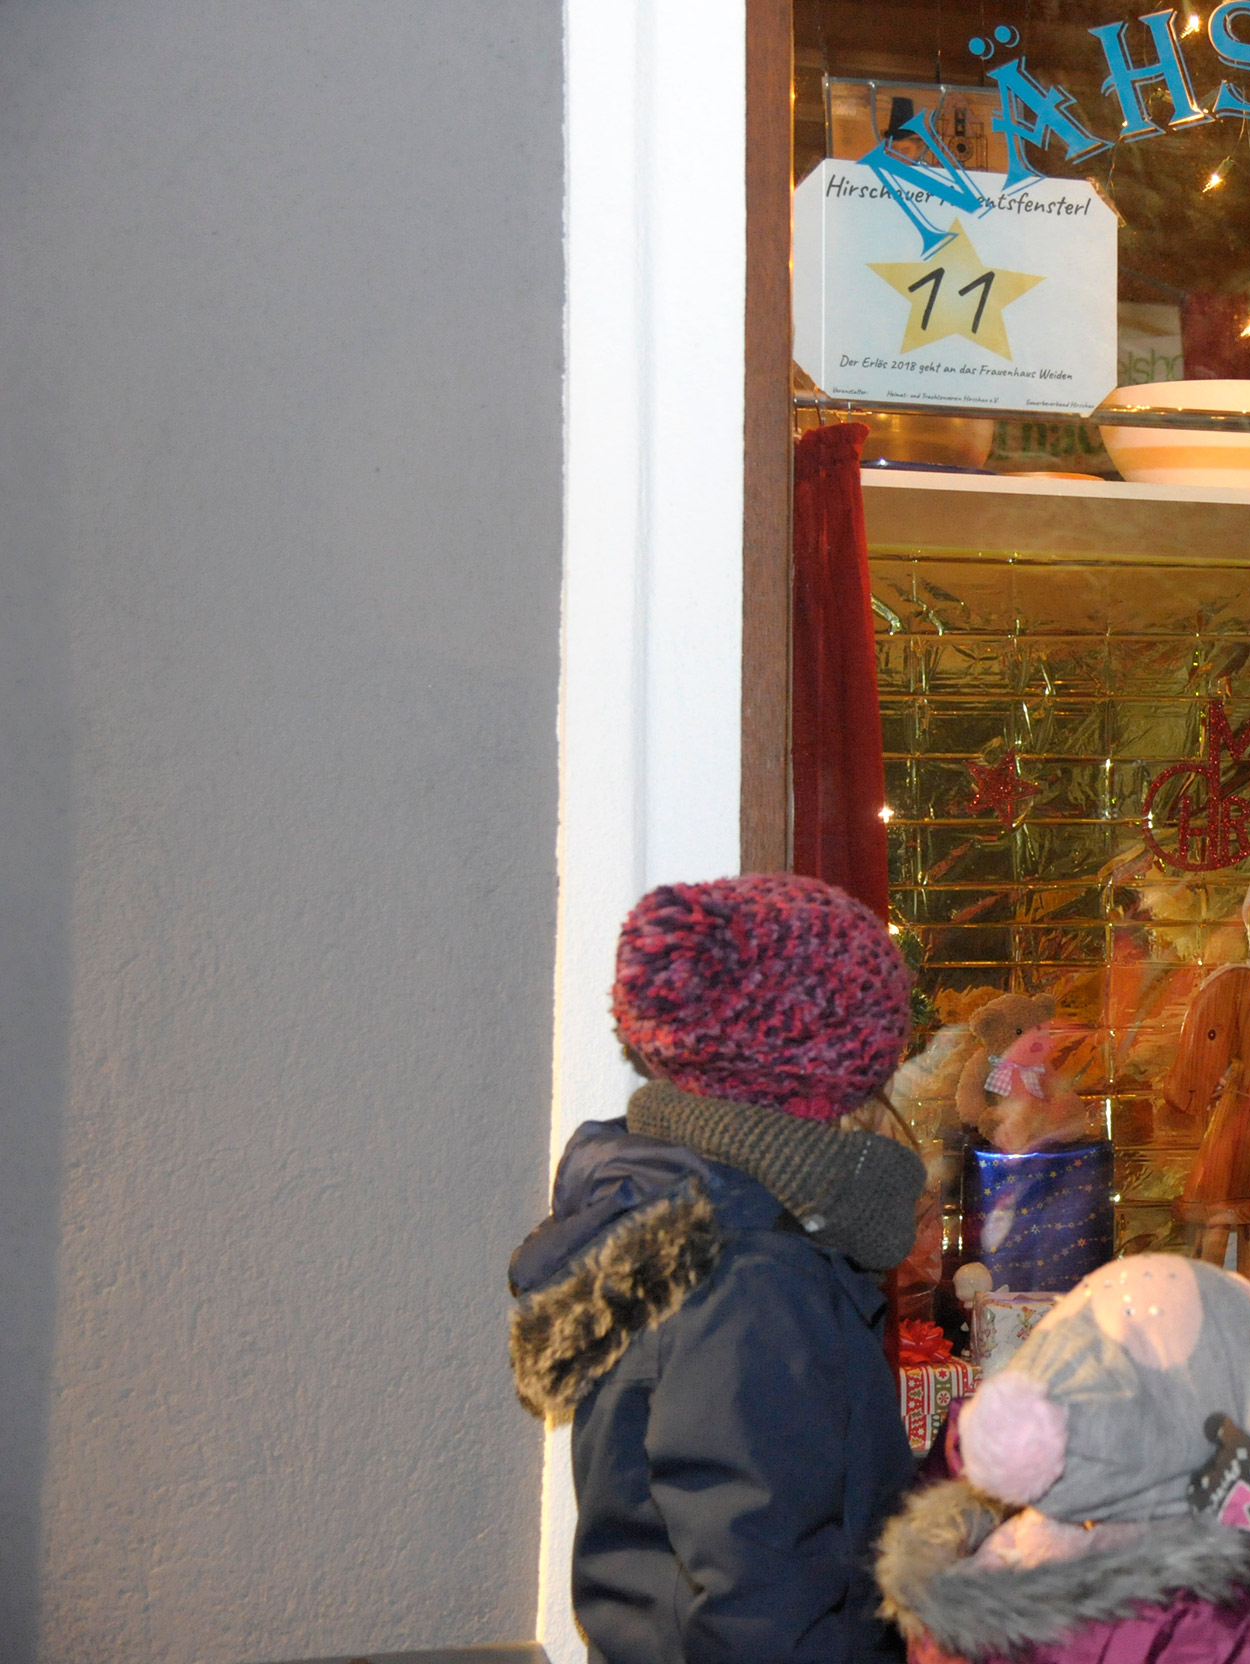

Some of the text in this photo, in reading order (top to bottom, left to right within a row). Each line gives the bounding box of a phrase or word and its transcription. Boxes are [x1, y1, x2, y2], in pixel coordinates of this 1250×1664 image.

[907, 266, 996, 334] 11
[840, 354, 1074, 380] Der Erlös 2018 geht an das Frauenhaus Weiden
